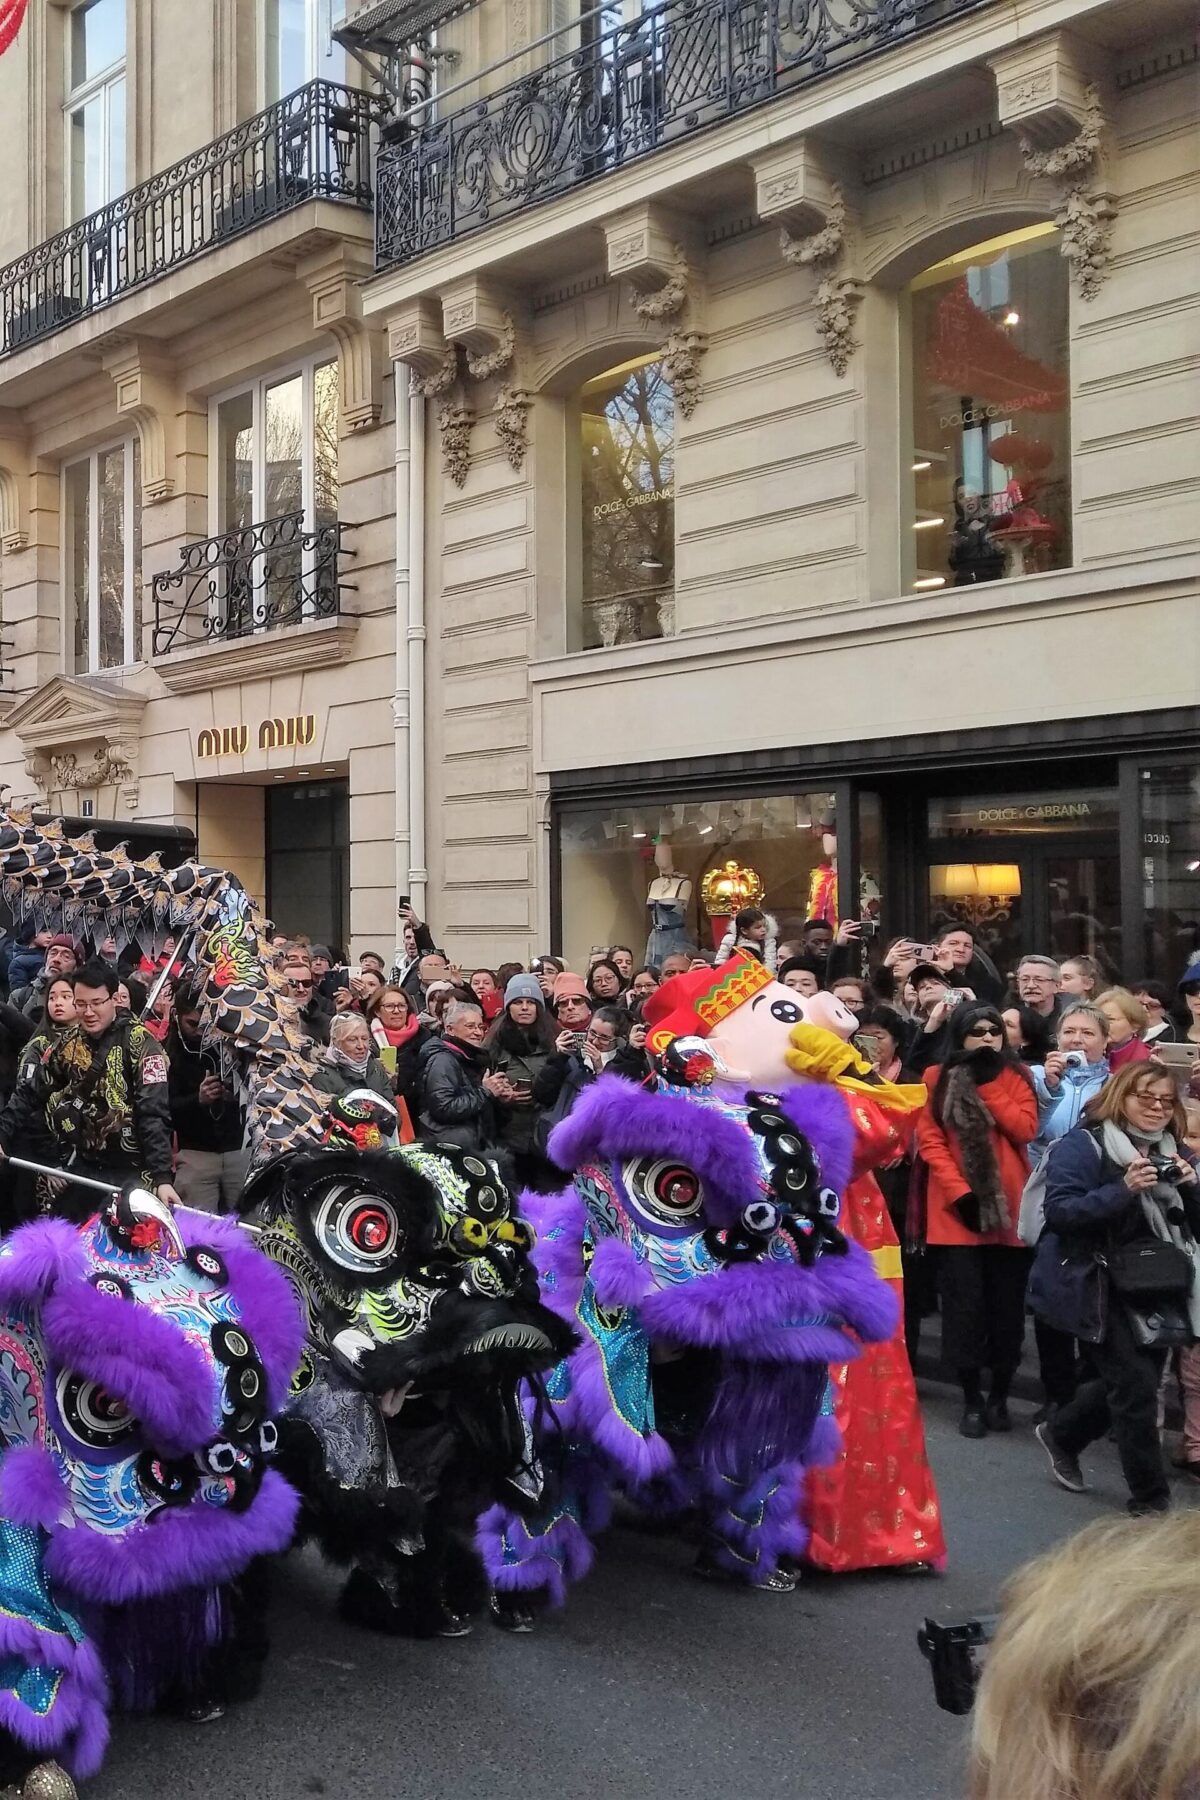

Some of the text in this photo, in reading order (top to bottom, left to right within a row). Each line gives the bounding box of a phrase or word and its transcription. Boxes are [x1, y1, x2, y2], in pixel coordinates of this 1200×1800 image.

[593, 497, 622, 516] DOLCE
[626, 488, 673, 508] GABBANA
[197, 714, 316, 758] MIU MIU
[979, 807, 1017, 821] DOLCE
[1025, 803, 1091, 819] GABBANA
